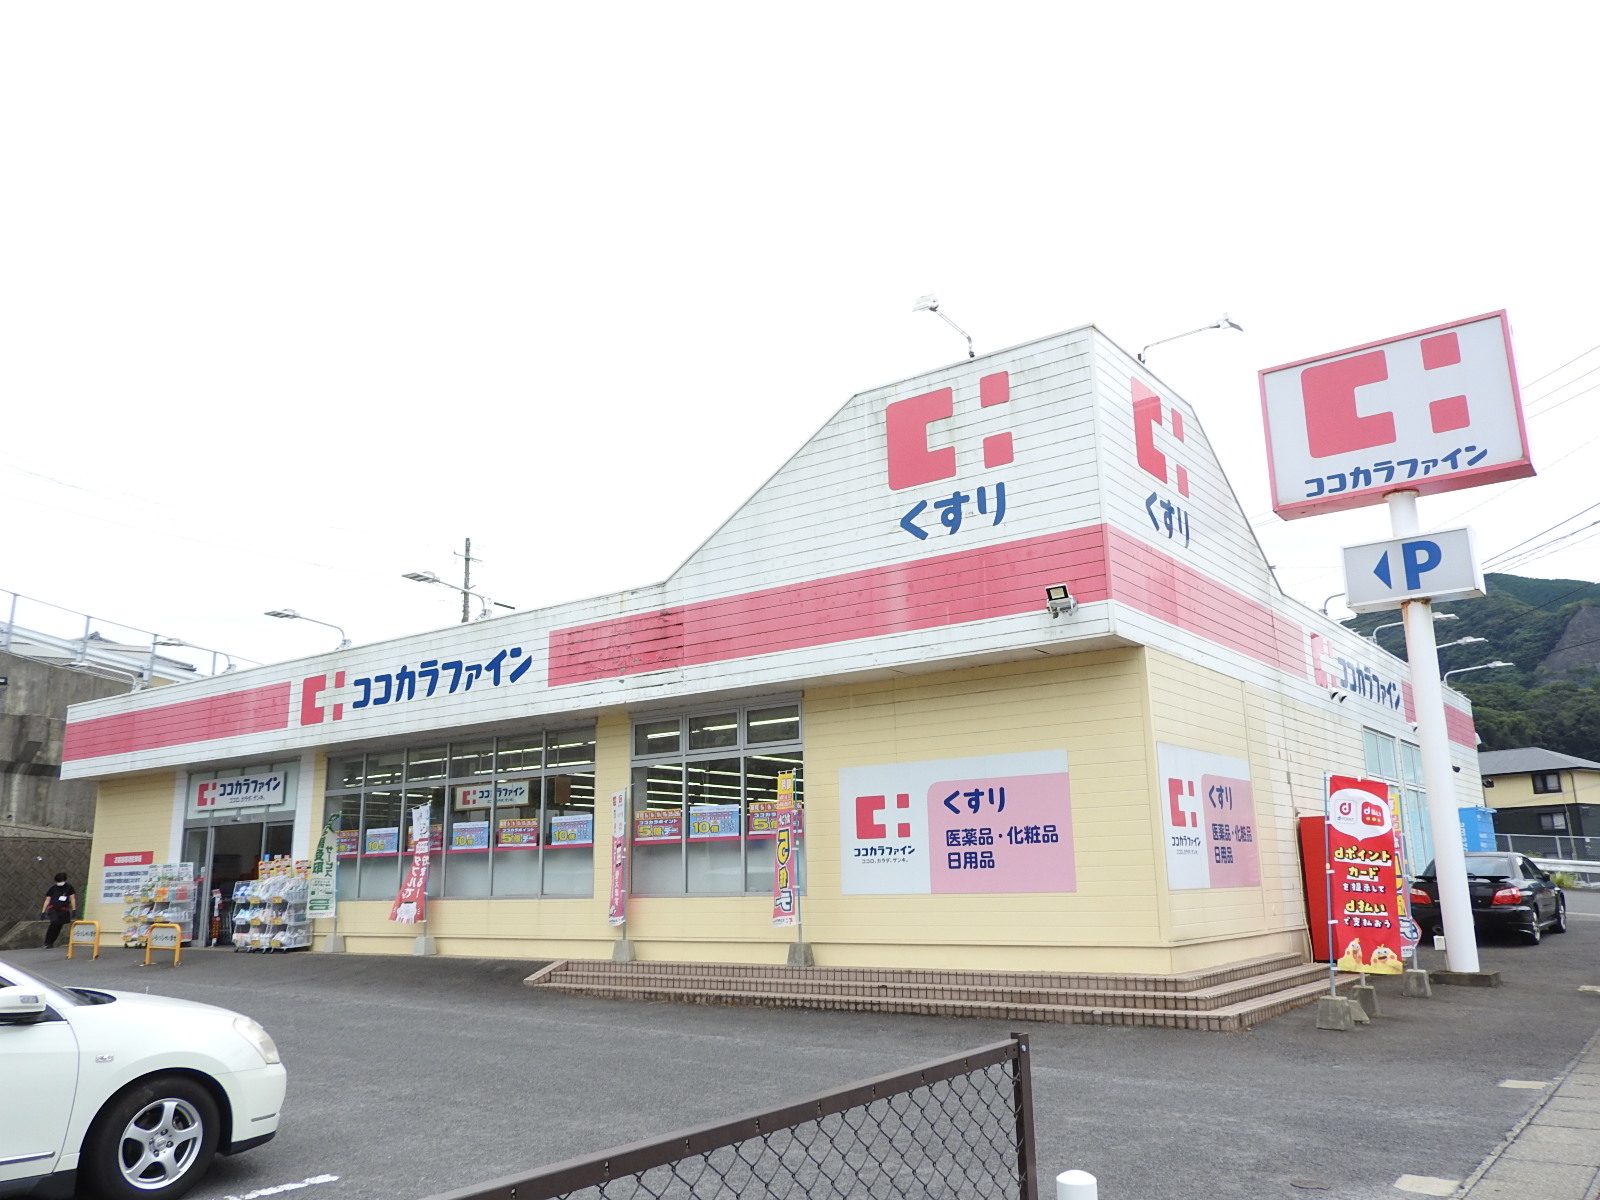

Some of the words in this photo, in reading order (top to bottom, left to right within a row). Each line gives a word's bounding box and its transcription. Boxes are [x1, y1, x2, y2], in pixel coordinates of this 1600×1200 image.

[1304, 445, 1488, 497] ココカラファイン
[900, 482, 1006, 540] くすり
[1145, 491, 1191, 549] くすり
[1402, 541, 1442, 591] P
[352, 647, 533, 709] ココカラファイン
[1337, 656, 1401, 710] ココカラファイン
[219, 777, 281, 796] ココカラファイン
[479, 787, 525, 799] ココラファイン
[944, 786, 1006, 815] くすり
[1208, 784, 1233, 811] くすり
[946, 825, 1059, 847] 医薬品・化粧品
[1171, 836, 1202, 847] ココカラファイン
[1211, 823, 1253, 843] 医薬品・化粧品
[853, 846, 916, 858] ココカラファイン
[948, 851, 996, 870] 日用品
[1214, 846, 1234, 864] 日用品
[1335, 846, 1391, 862] dポイント
[1348, 866, 1379, 879] カード
[1342, 883, 1386, 893] を提示して
[1345, 899, 1386, 912] d払い
[1343, 917, 1391, 929] で支払おう
